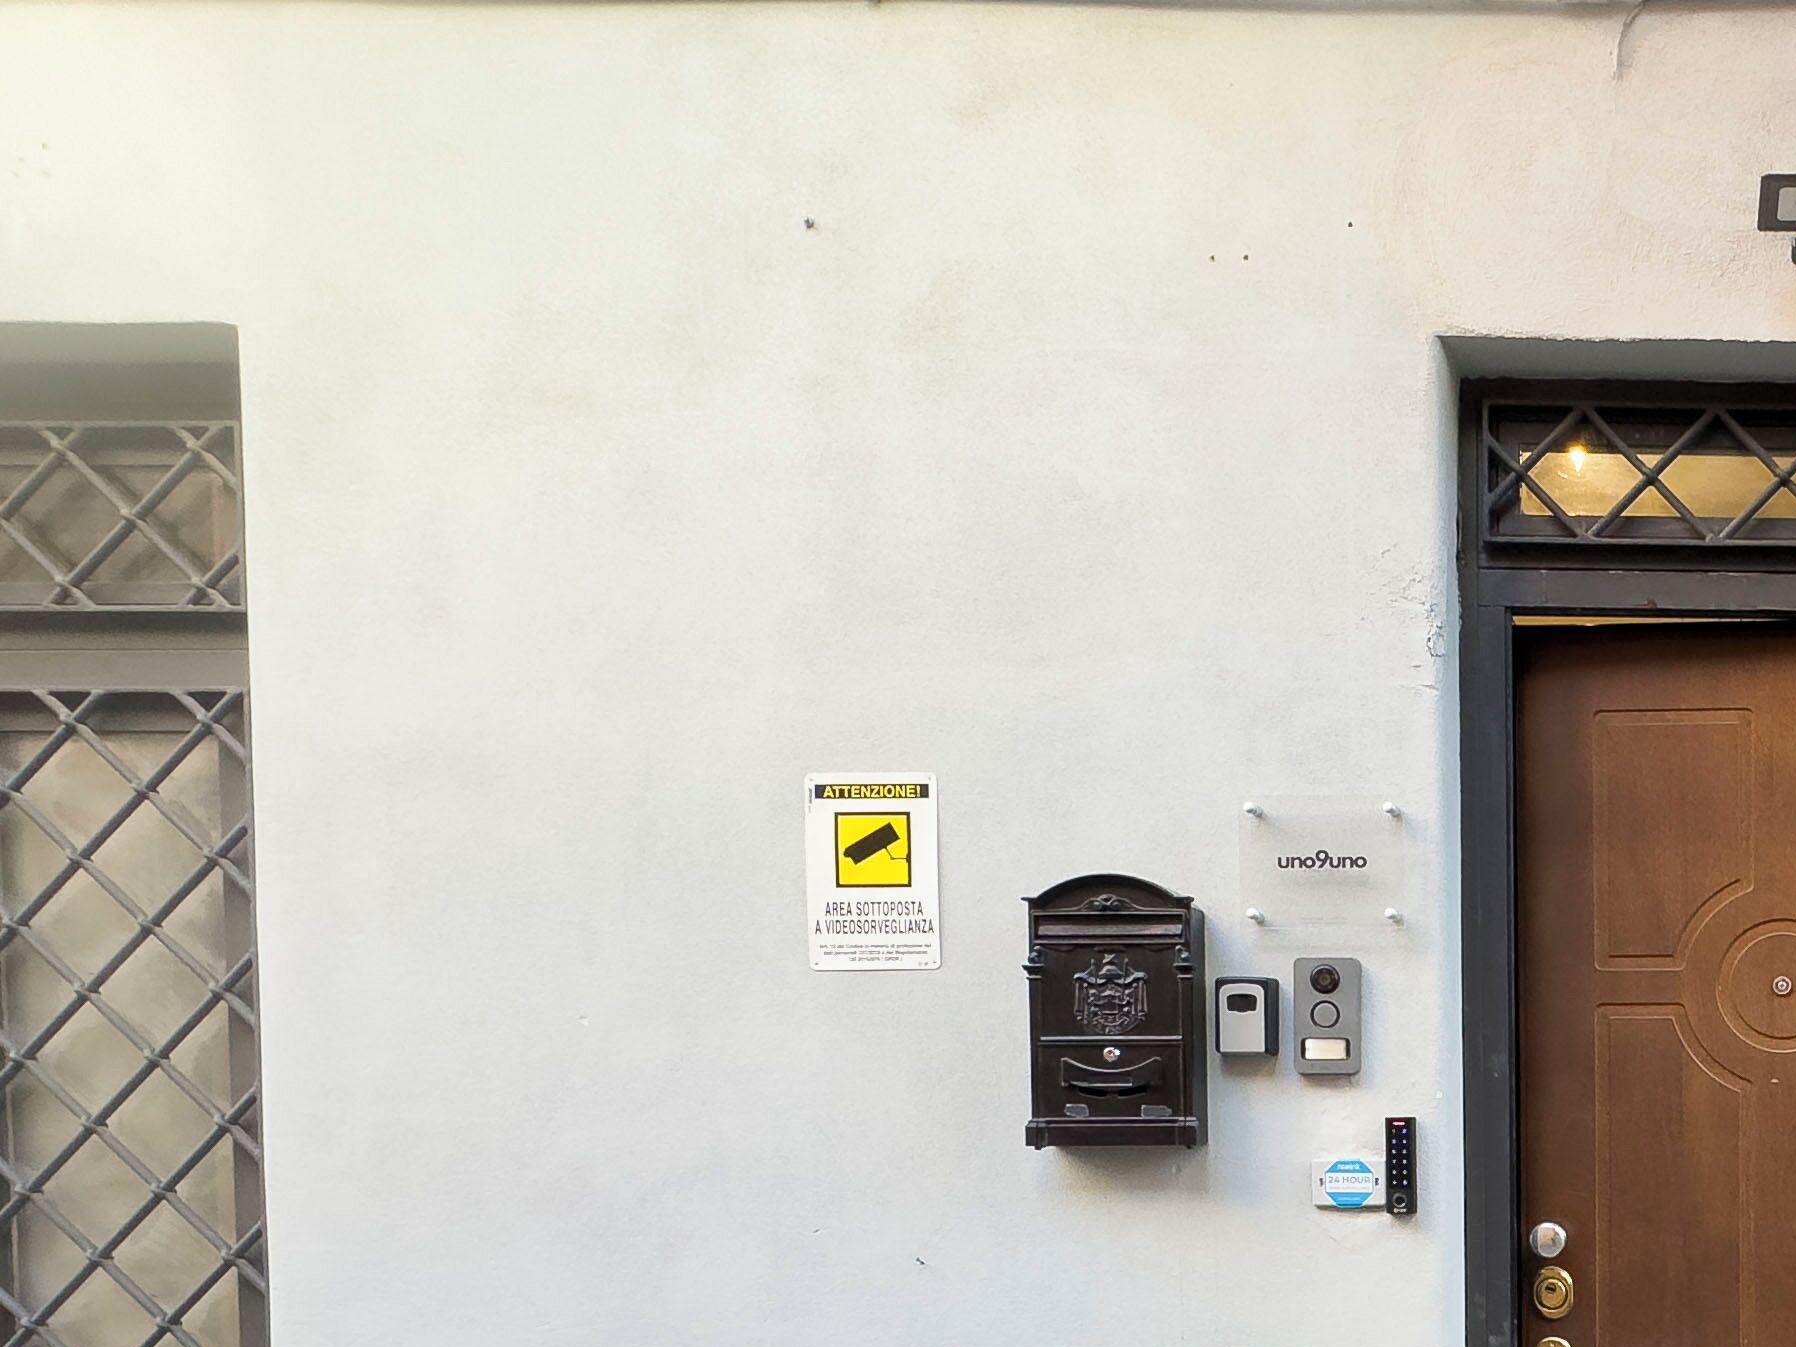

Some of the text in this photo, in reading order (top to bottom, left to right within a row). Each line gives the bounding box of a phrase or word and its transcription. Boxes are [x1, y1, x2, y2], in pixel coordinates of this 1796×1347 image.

[823, 784, 921, 798] ATTENZIONE!
[1277, 849, 1368, 869] uno9uno
[825, 901, 923, 917] AREA SOTTOPOSTA
[815, 919, 934, 934] A VIDEOSORVEGLIANZA
[1328, 1175, 1371, 1184] 24 HOUR
